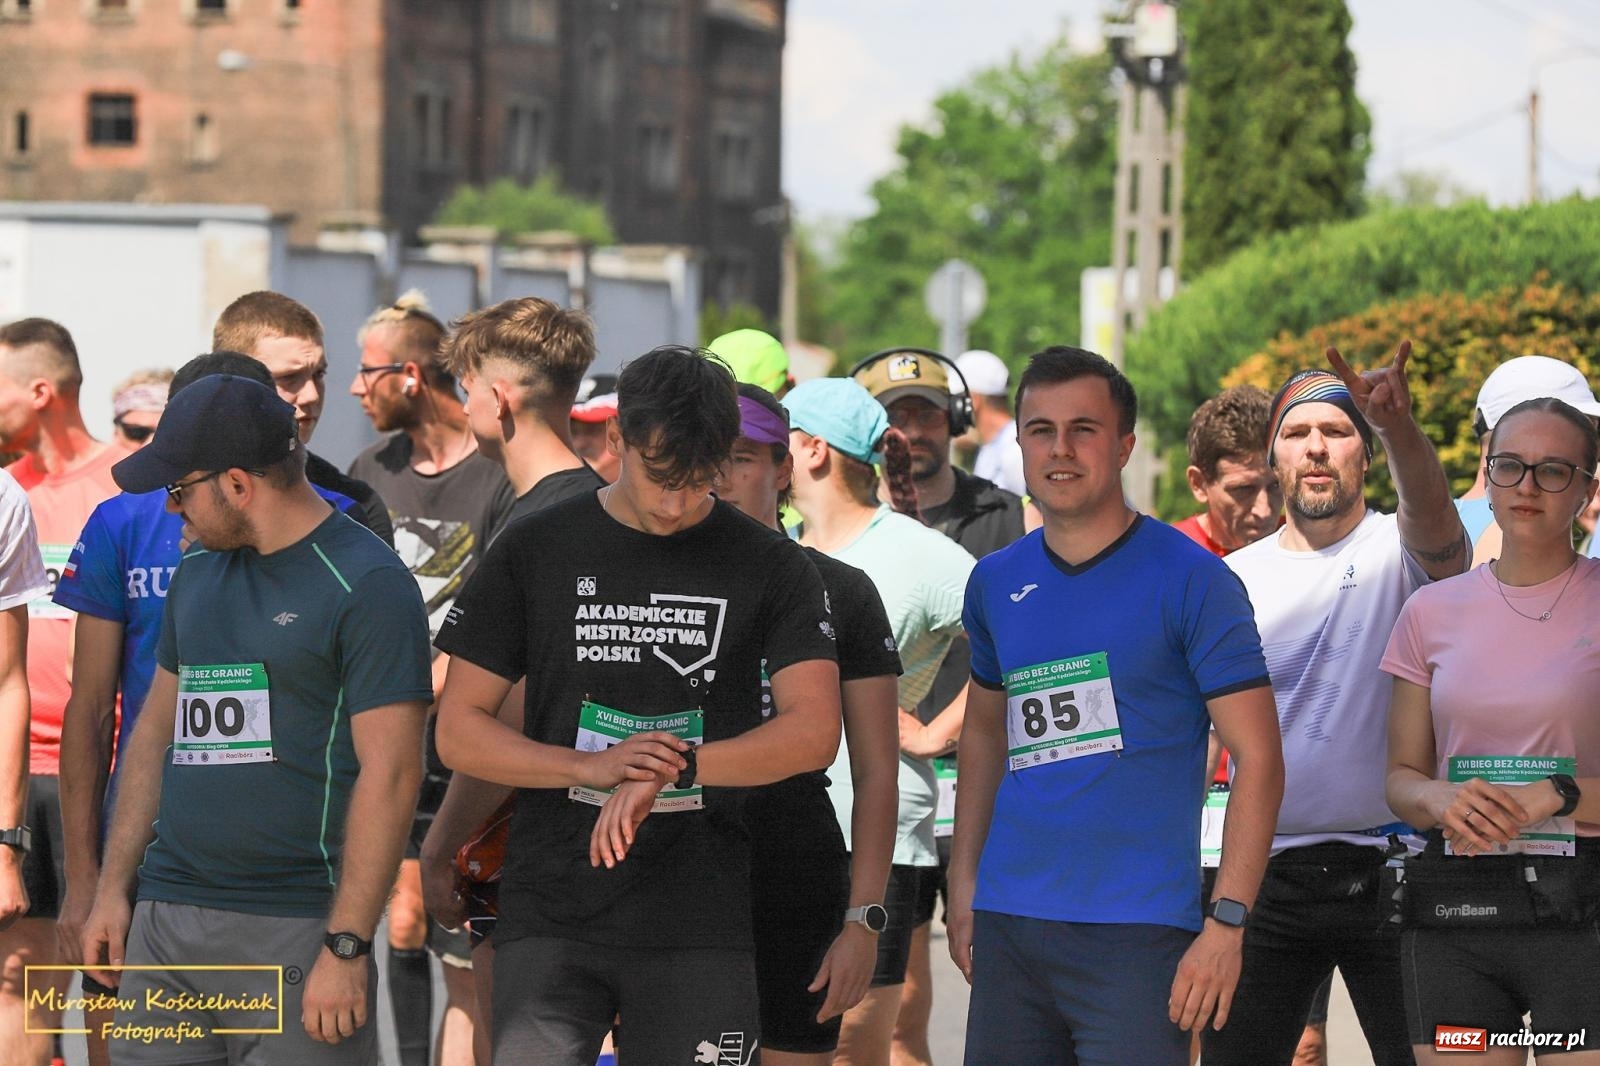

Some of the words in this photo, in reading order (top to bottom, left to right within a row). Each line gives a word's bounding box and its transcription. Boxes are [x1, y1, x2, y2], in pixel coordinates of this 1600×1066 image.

[272, 611, 299, 626] 4F
[575, 604, 707, 625] AKADEMICKIE
[575, 624, 707, 646] MISTRZOSTWA
[576, 645, 641, 662] POLSKI
[195, 669, 210, 679] BEZ
[212, 668, 253, 678] GRANIC
[1013, 671, 1030, 682] BIEG
[1031, 666, 1049, 677] BEZ
[1050, 659, 1091, 673] GRANIC
[182, 697, 245, 738] 100
[596, 709, 612, 721] XVI
[613, 715, 634, 728] BIEG
[635, 721, 655, 730] BEZ
[656, 716, 689, 729] GRANIC
[1022, 690, 1081, 738] 85
[1457, 760, 1470, 769] XVI
[1470, 759, 1492, 769] BIEG
[1494, 759, 1513, 769] BEZ
[1515, 759, 1558, 769] GRANIC
[1435, 904, 1498, 919] GymBeam
